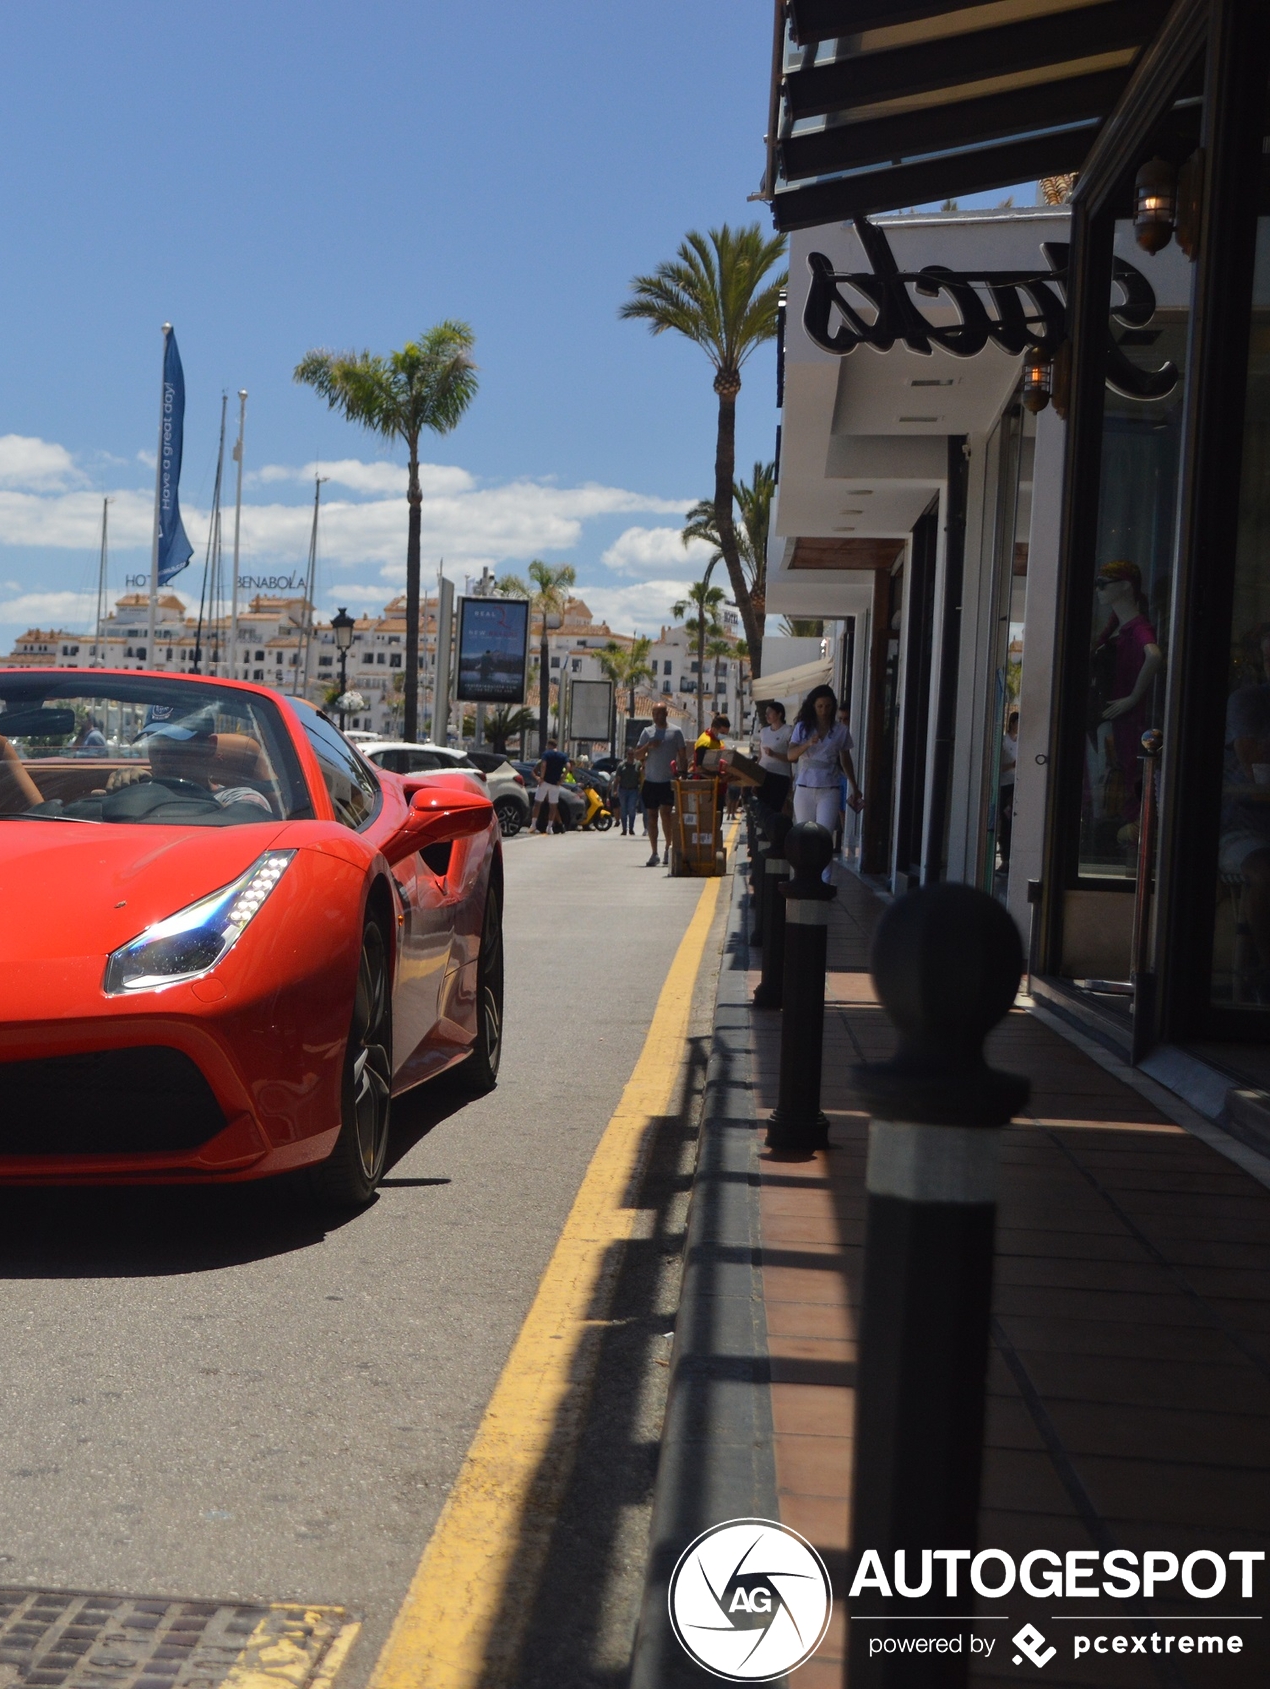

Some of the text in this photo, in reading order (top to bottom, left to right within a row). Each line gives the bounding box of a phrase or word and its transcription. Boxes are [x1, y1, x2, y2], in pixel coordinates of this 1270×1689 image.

[162, 382, 175, 510] Have a great day!
[237, 576, 306, 589] BENABOLA
